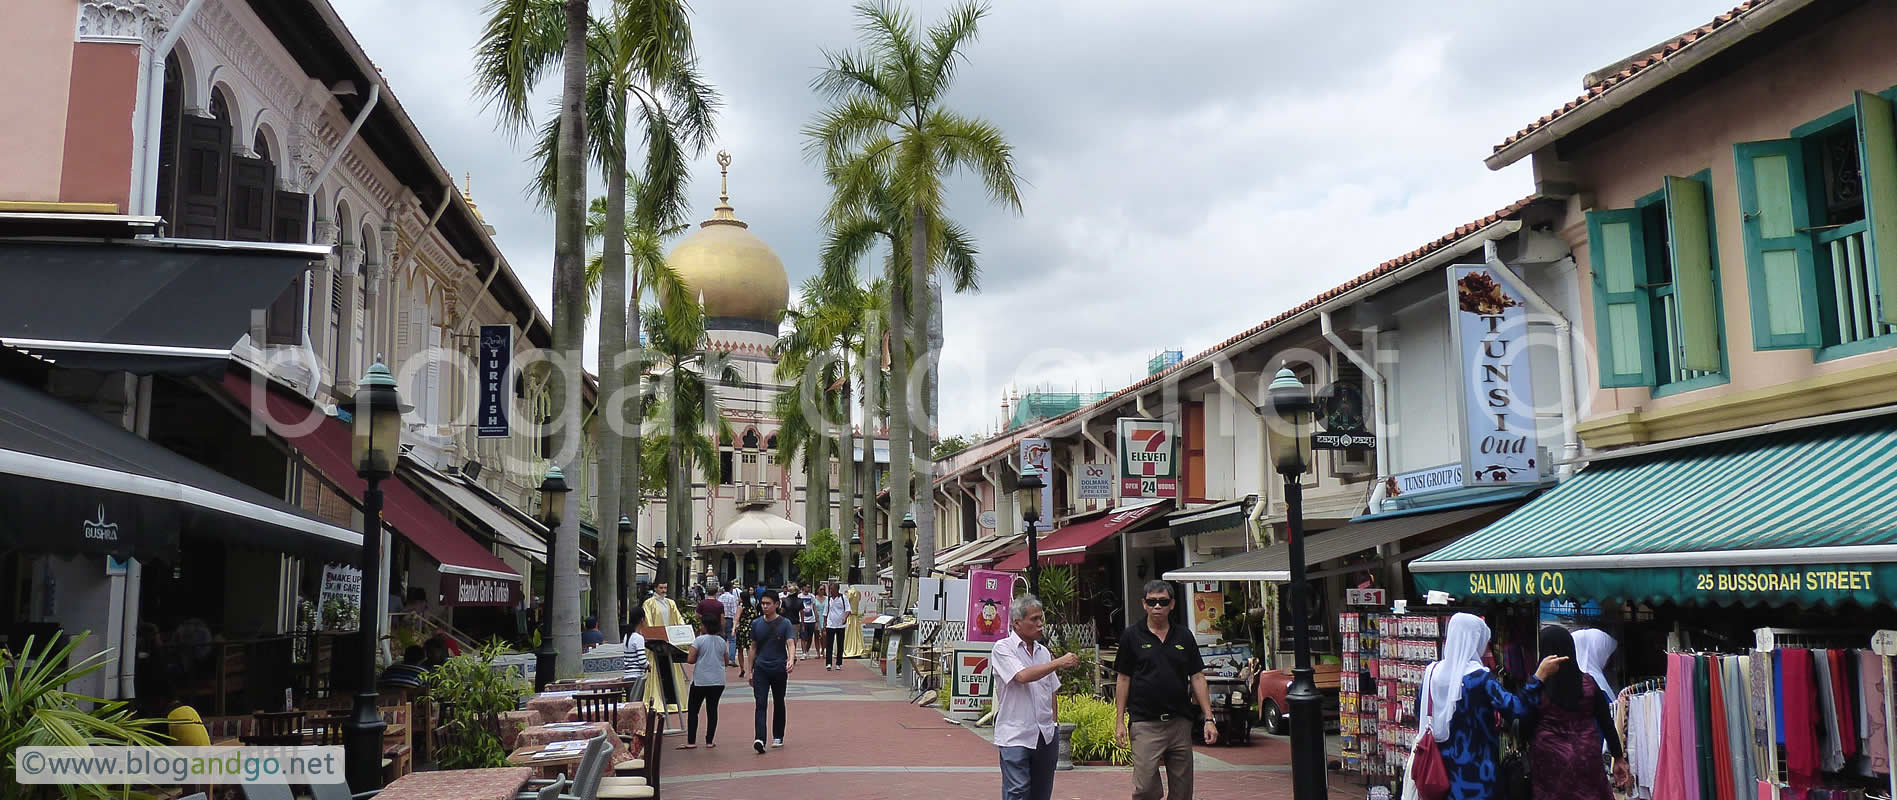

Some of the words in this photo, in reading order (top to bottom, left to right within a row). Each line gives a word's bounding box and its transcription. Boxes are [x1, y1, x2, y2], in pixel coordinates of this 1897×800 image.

[1480, 315, 1512, 431] TUNSI
[488, 349, 499, 425] TURKISH
[1131, 429, 1166, 476] 7
[1480, 435, 1527, 455] Oud
[1142, 480, 1156, 493] 24
[1404, 474, 1426, 491] TUNSI
[1426, 469, 1453, 488] GROUP
[85, 527, 118, 540] BUSHRA
[331, 573, 351, 583] MAKE
[352, 575, 361, 584] UP
[343, 583, 360, 593] CARE
[1470, 573, 1521, 594] SALMIN
[1525, 572, 1536, 595] &
[1540, 571, 1567, 595] CO.
[1696, 573, 1715, 590] 25
[1718, 572, 1801, 591] BUSSORAH
[1806, 570, 1872, 591] STREET
[968, 698, 979, 709] 24
